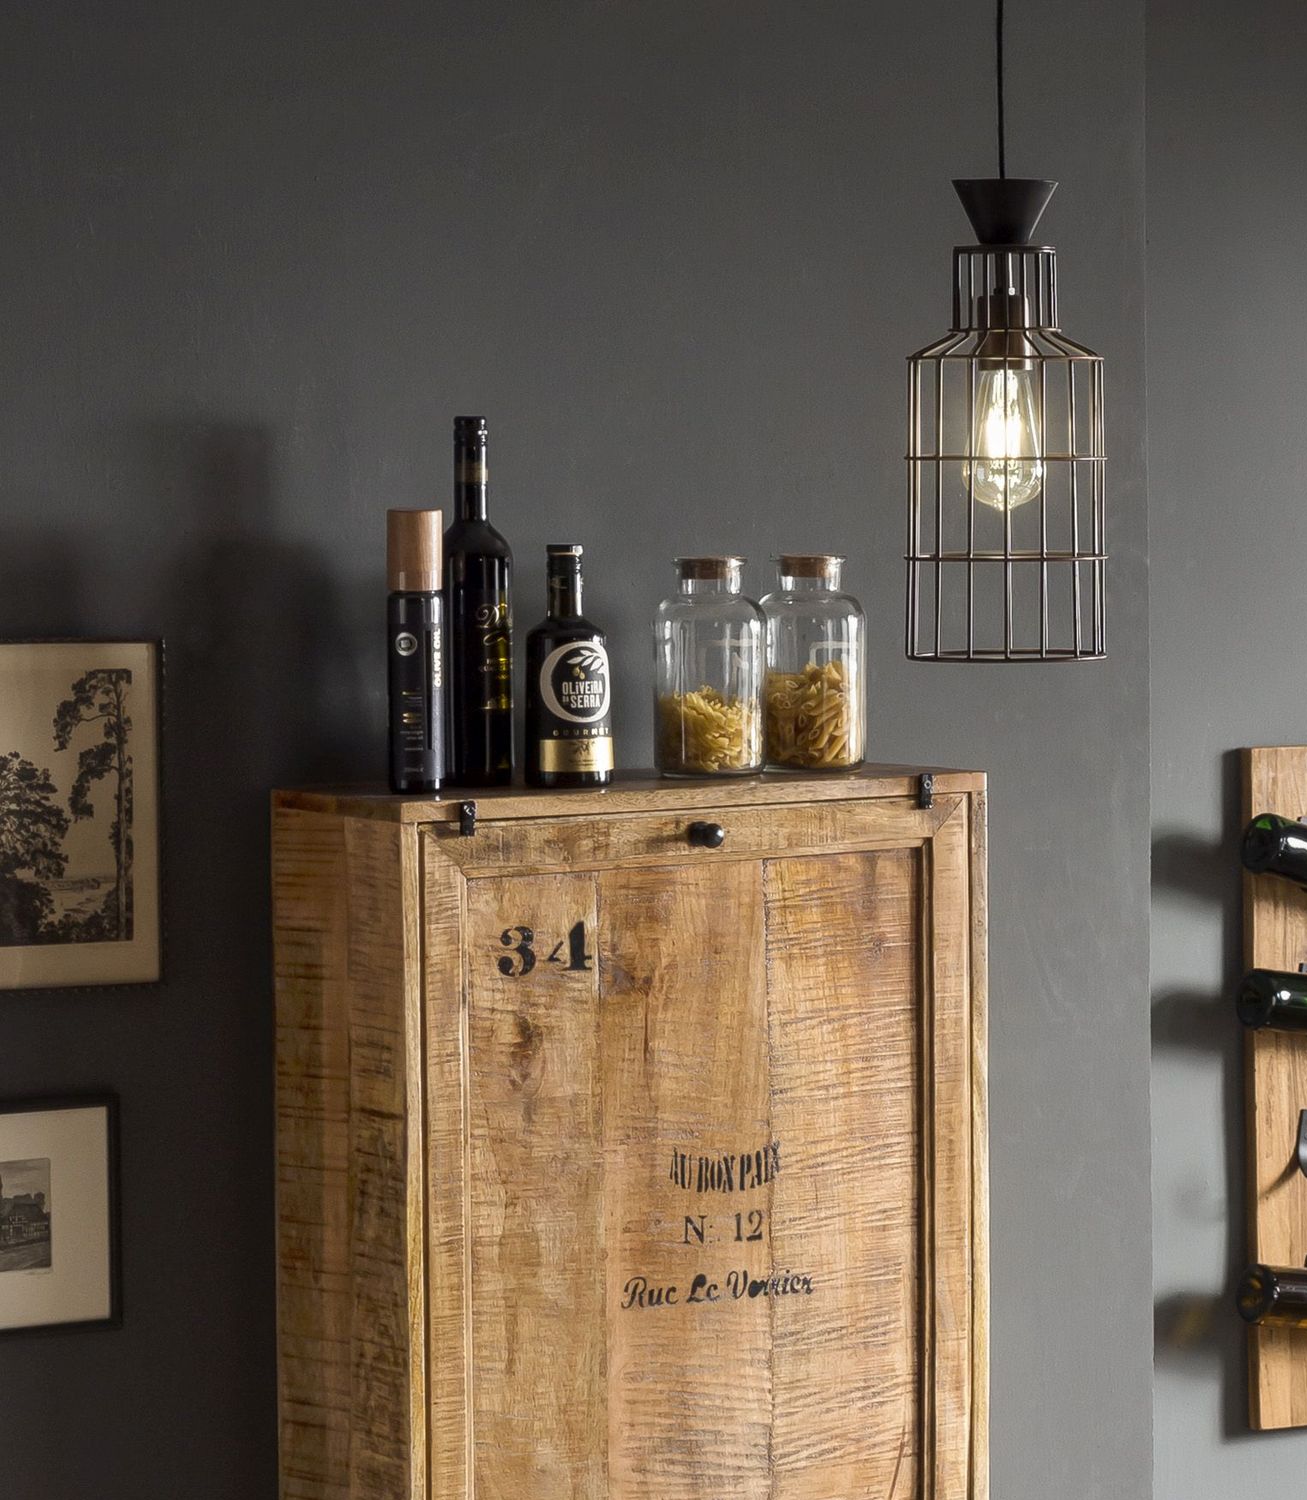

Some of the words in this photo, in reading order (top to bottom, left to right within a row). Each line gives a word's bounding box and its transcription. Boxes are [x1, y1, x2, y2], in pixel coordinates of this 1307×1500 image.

[570, 695, 601, 708] SERRA
[498, 920, 593, 977] 34
[734, 1209, 763, 1242] 12
